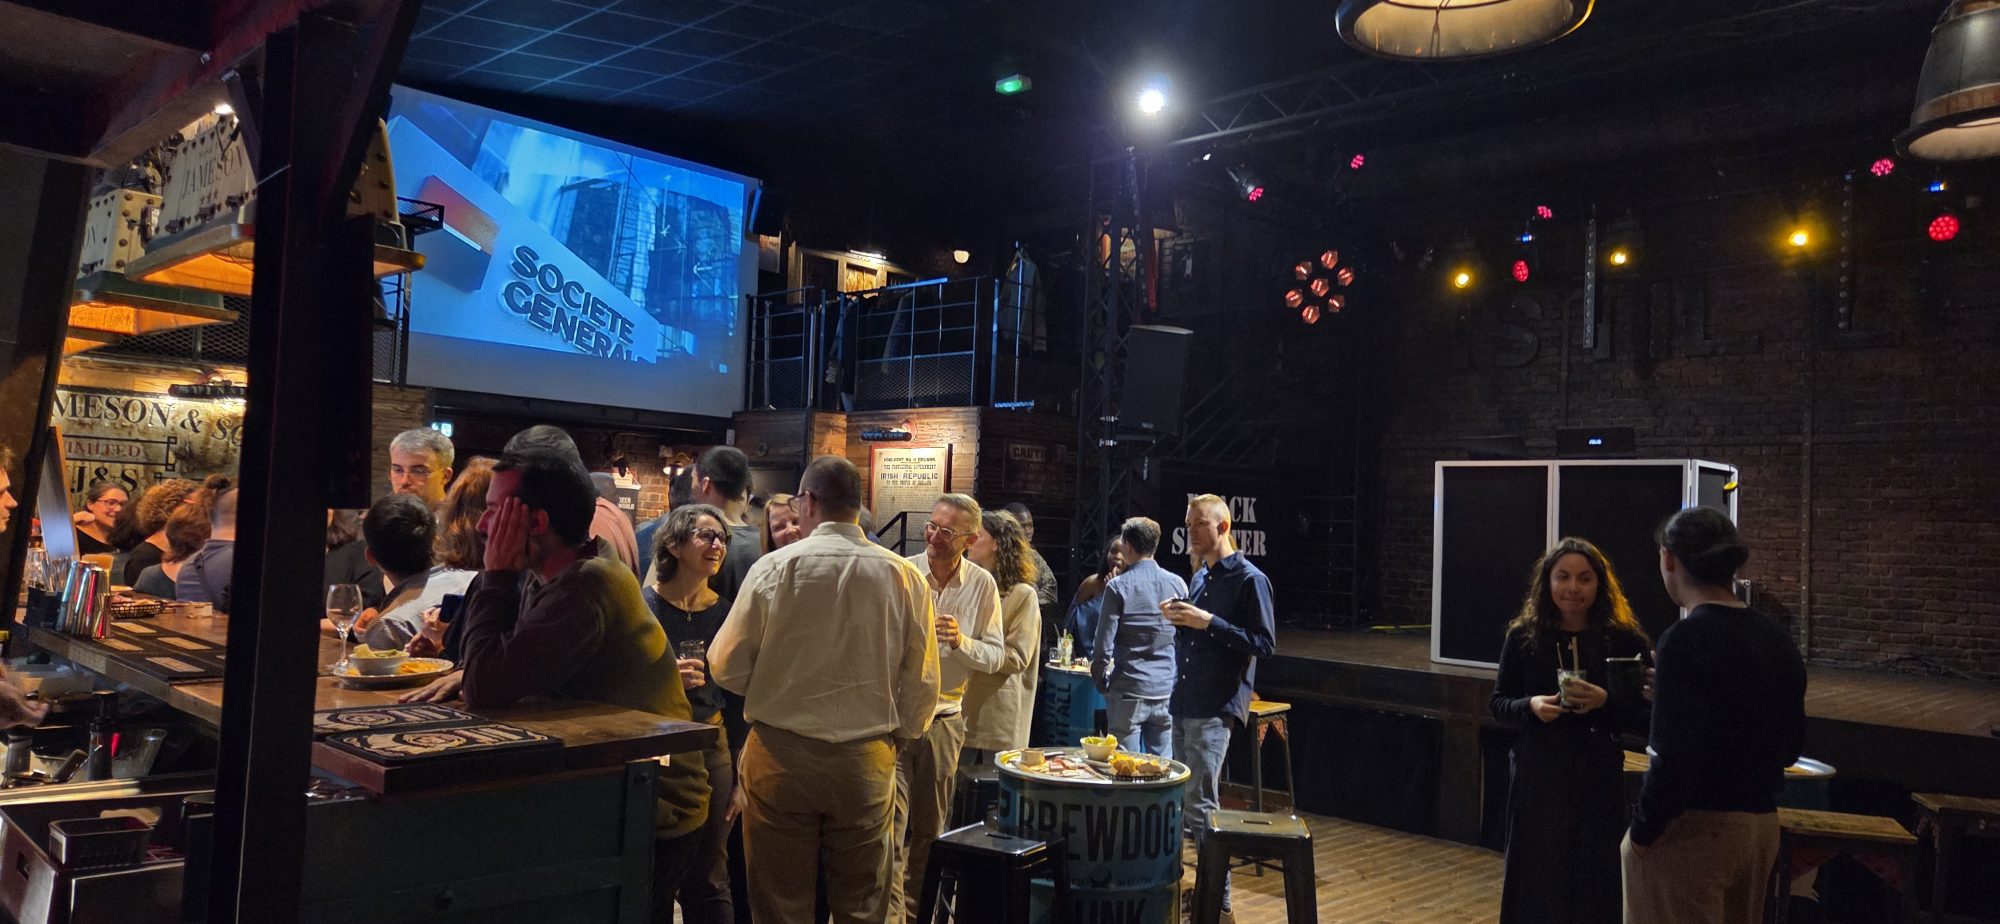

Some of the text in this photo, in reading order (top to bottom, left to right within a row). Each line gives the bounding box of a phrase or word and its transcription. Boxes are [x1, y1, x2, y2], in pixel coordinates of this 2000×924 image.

[181, 146, 243, 199] JAMESON
[503, 281, 656, 363] GENERA
[511, 246, 635, 344] SOCIETE
[52, 394, 173, 428] MESON
[180, 409, 202, 434] &
[1171, 526, 1267, 556] STER
[1019, 796, 1175, 861] BREWDOG
